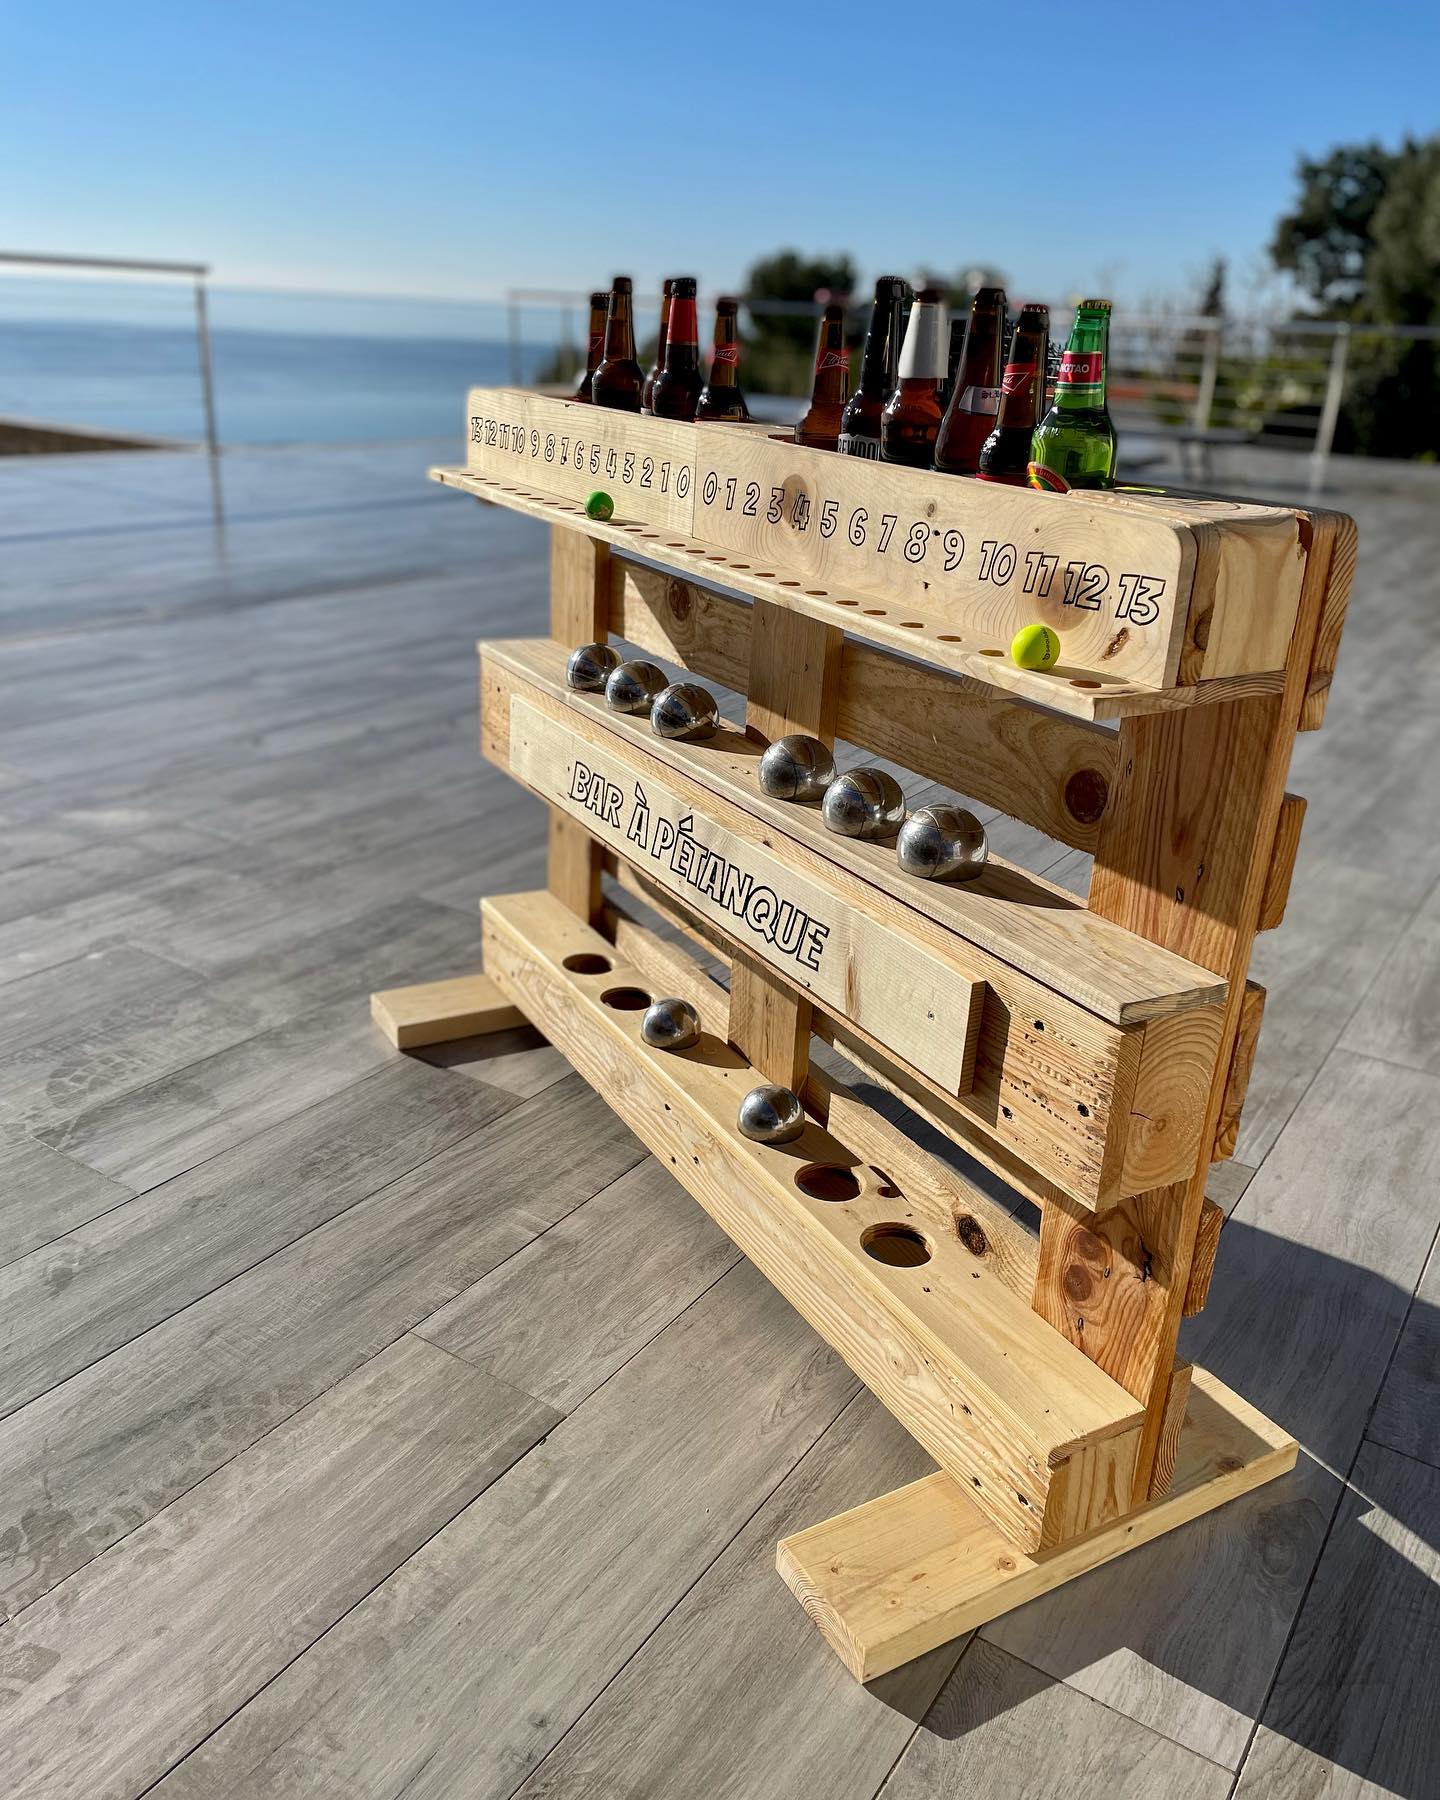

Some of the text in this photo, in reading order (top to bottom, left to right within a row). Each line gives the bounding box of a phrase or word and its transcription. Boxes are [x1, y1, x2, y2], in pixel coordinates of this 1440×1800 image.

[472, 417, 690, 498] 13 12 11 10 9 8 7 6 5 4 3 2 1 0
[702, 471, 1166, 626] 0 1 2 3 4 5 6 7 8 9 10 11 12 13
[569, 760, 831, 972] BAR À PÉTANQUE
